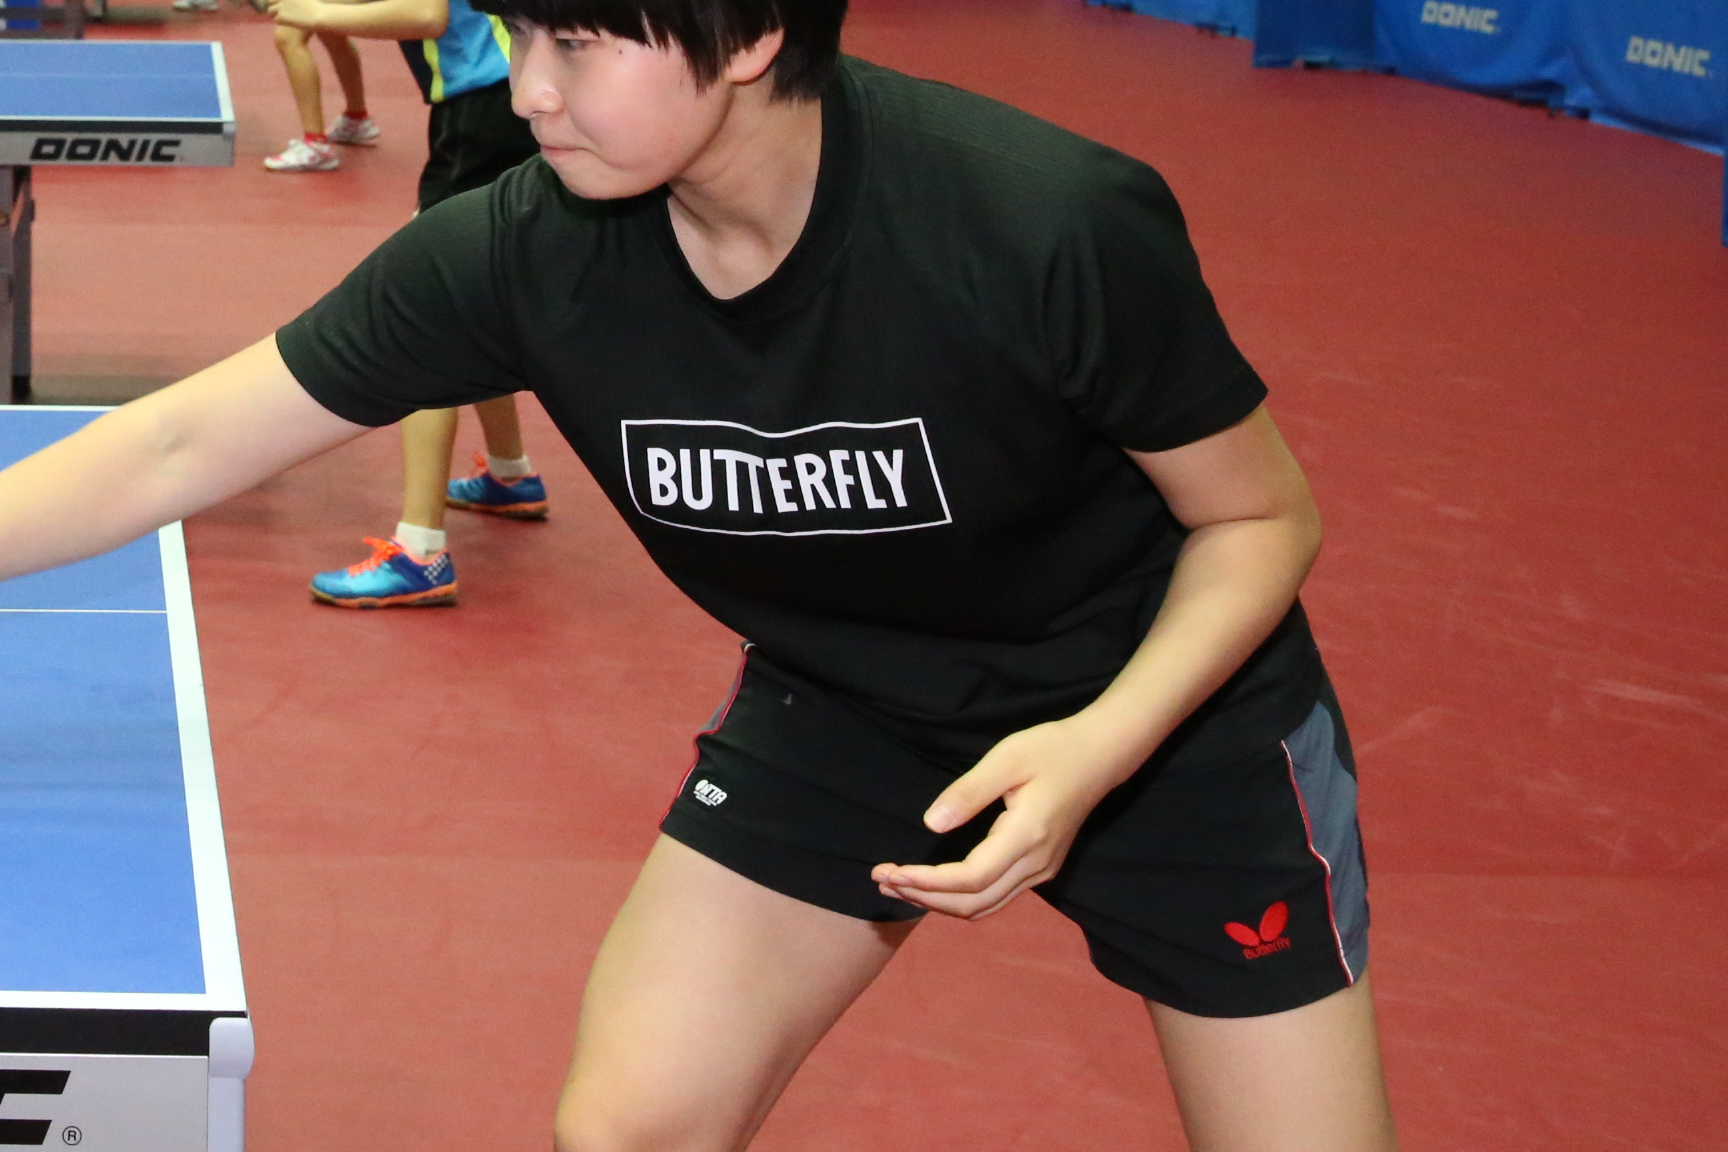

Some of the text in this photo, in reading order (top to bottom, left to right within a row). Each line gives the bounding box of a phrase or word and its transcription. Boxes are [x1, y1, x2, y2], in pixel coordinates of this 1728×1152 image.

[1422, 0, 1499, 34] DONIC
[1626, 35, 1711, 77] DONIC
[30, 138, 182, 162] DONIC
[646, 447, 909, 515] BUTTERFLY
